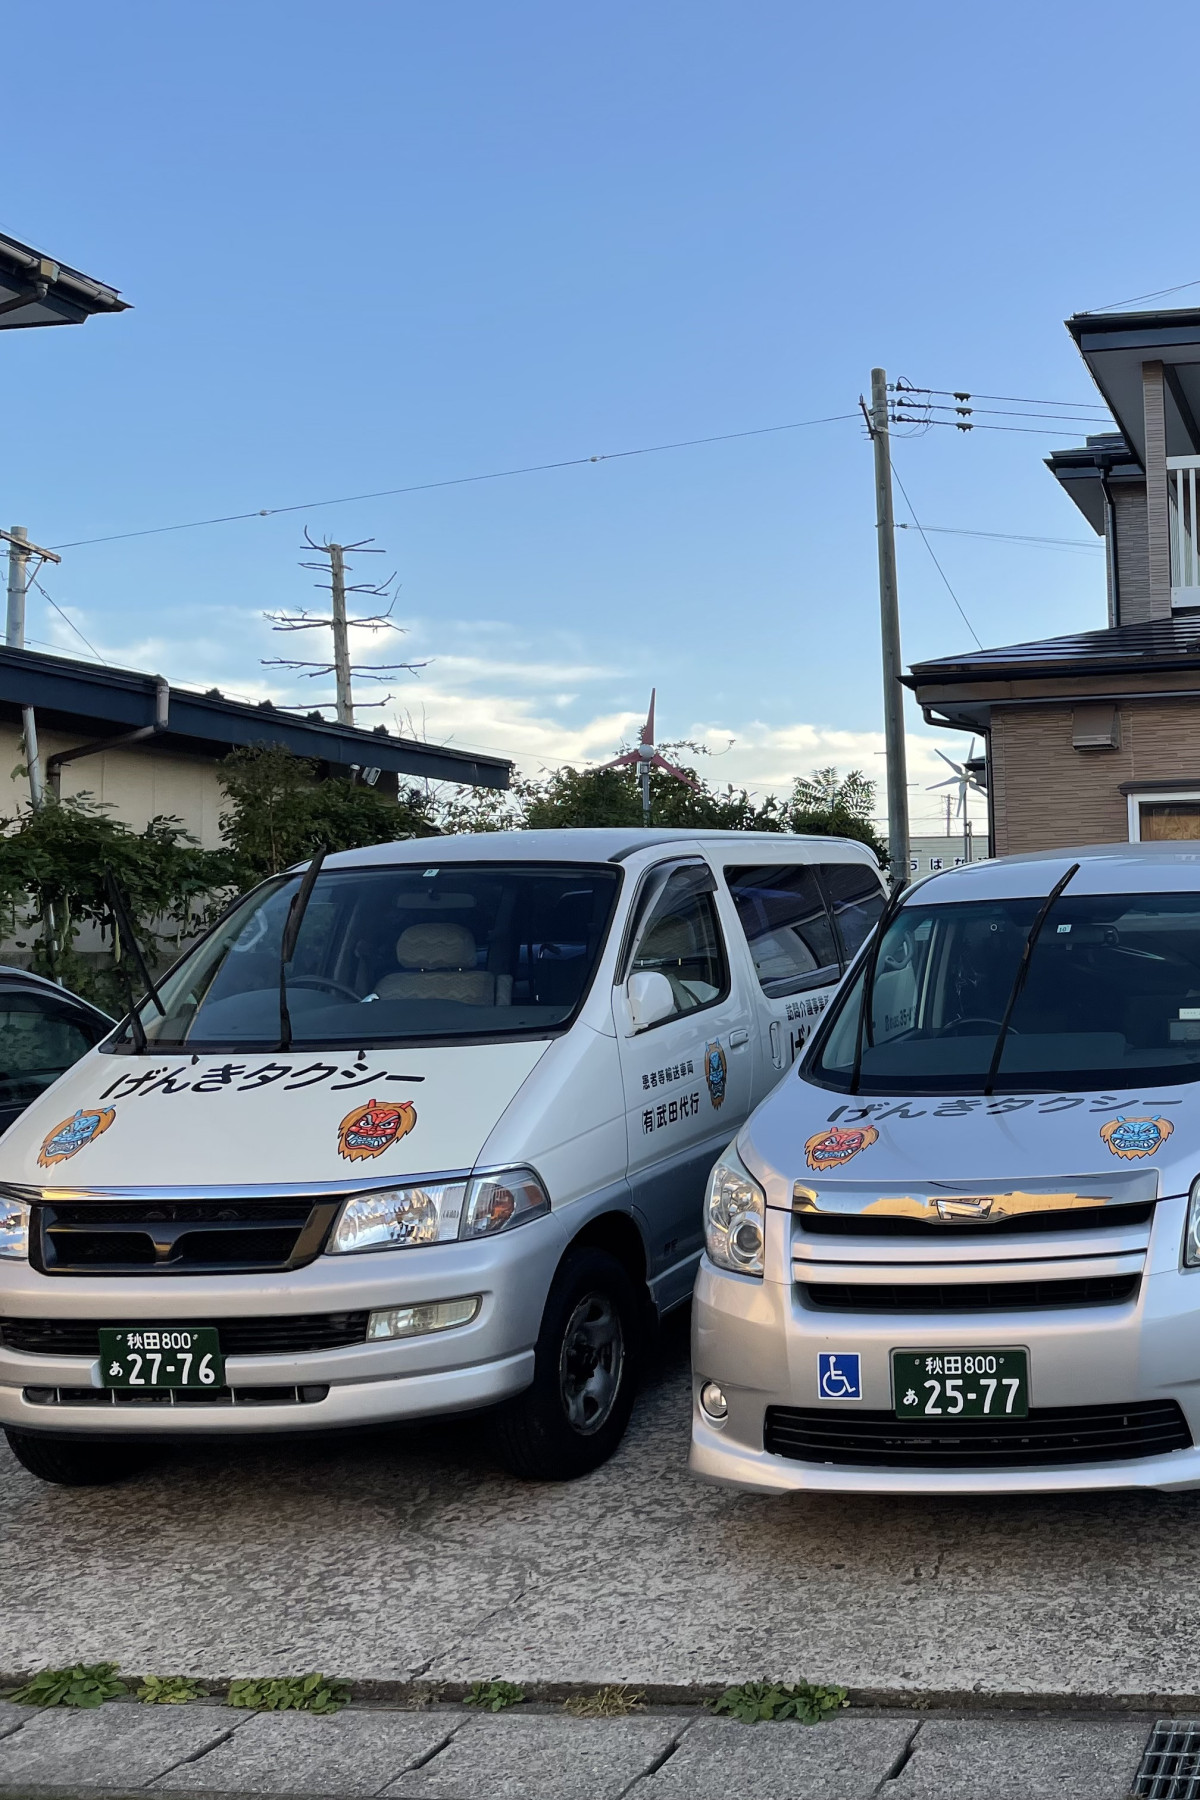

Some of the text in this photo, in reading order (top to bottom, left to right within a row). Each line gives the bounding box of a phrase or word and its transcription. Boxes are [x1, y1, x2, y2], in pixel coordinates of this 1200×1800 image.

[99, 1062, 425, 1100] げんきタクシー
[826, 1095, 1183, 1123] げんきタクシー
[109, 1353, 216, 1385] あ 27-76
[902, 1378, 1020, 1414] あ 25-77
